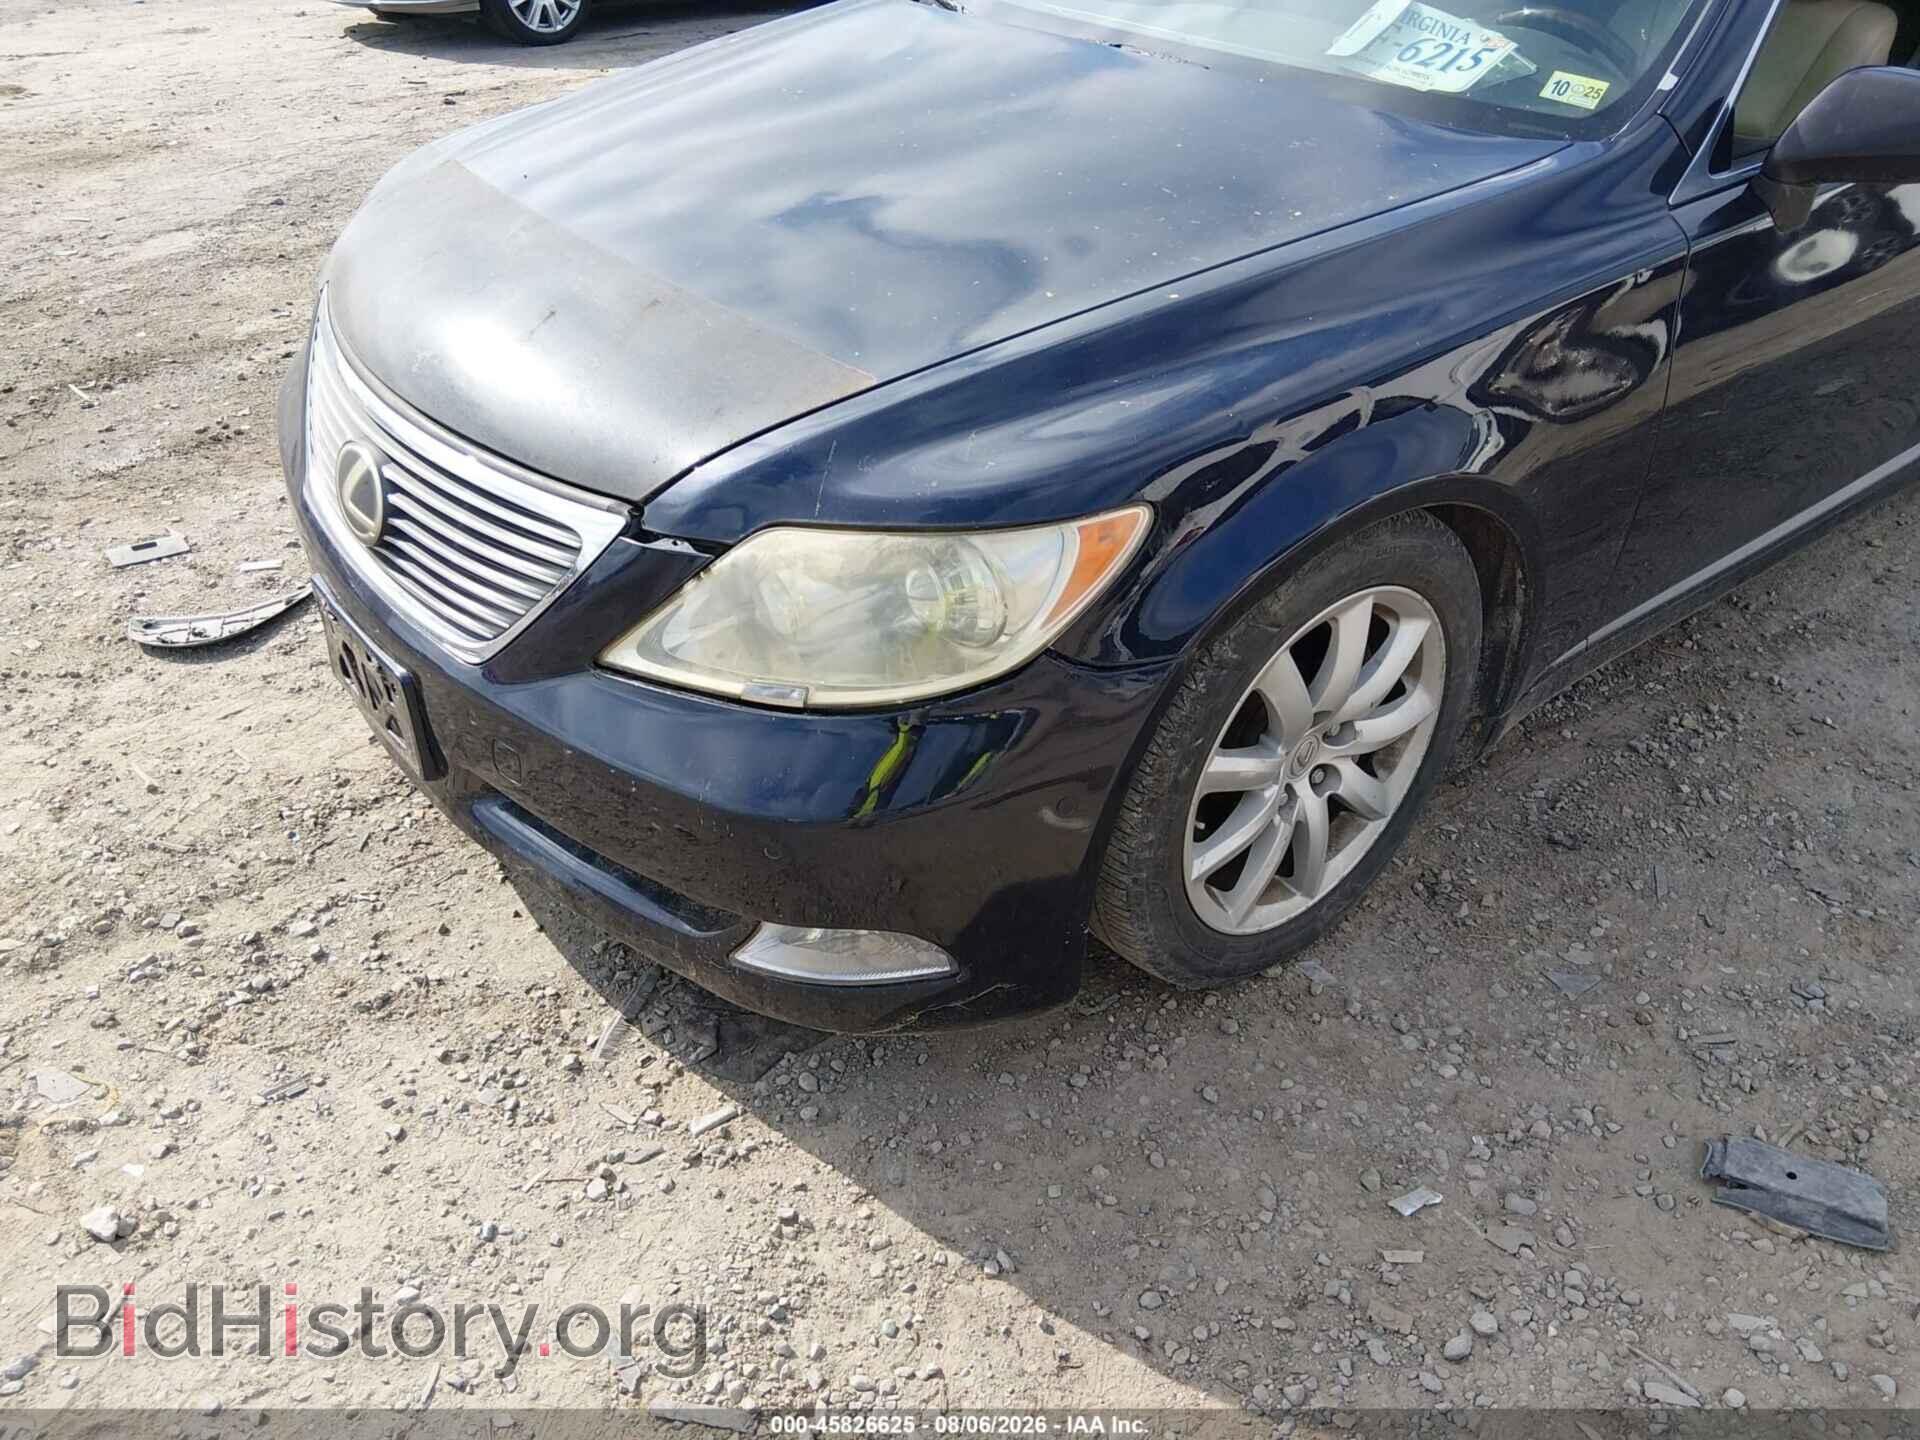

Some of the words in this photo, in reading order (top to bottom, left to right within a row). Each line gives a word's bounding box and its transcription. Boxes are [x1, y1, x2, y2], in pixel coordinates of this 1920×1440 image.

[1400, 8, 1472, 45] IRGINIA
[1551, 79, 1571, 97] 10
[1584, 86, 1603, 99] 25
